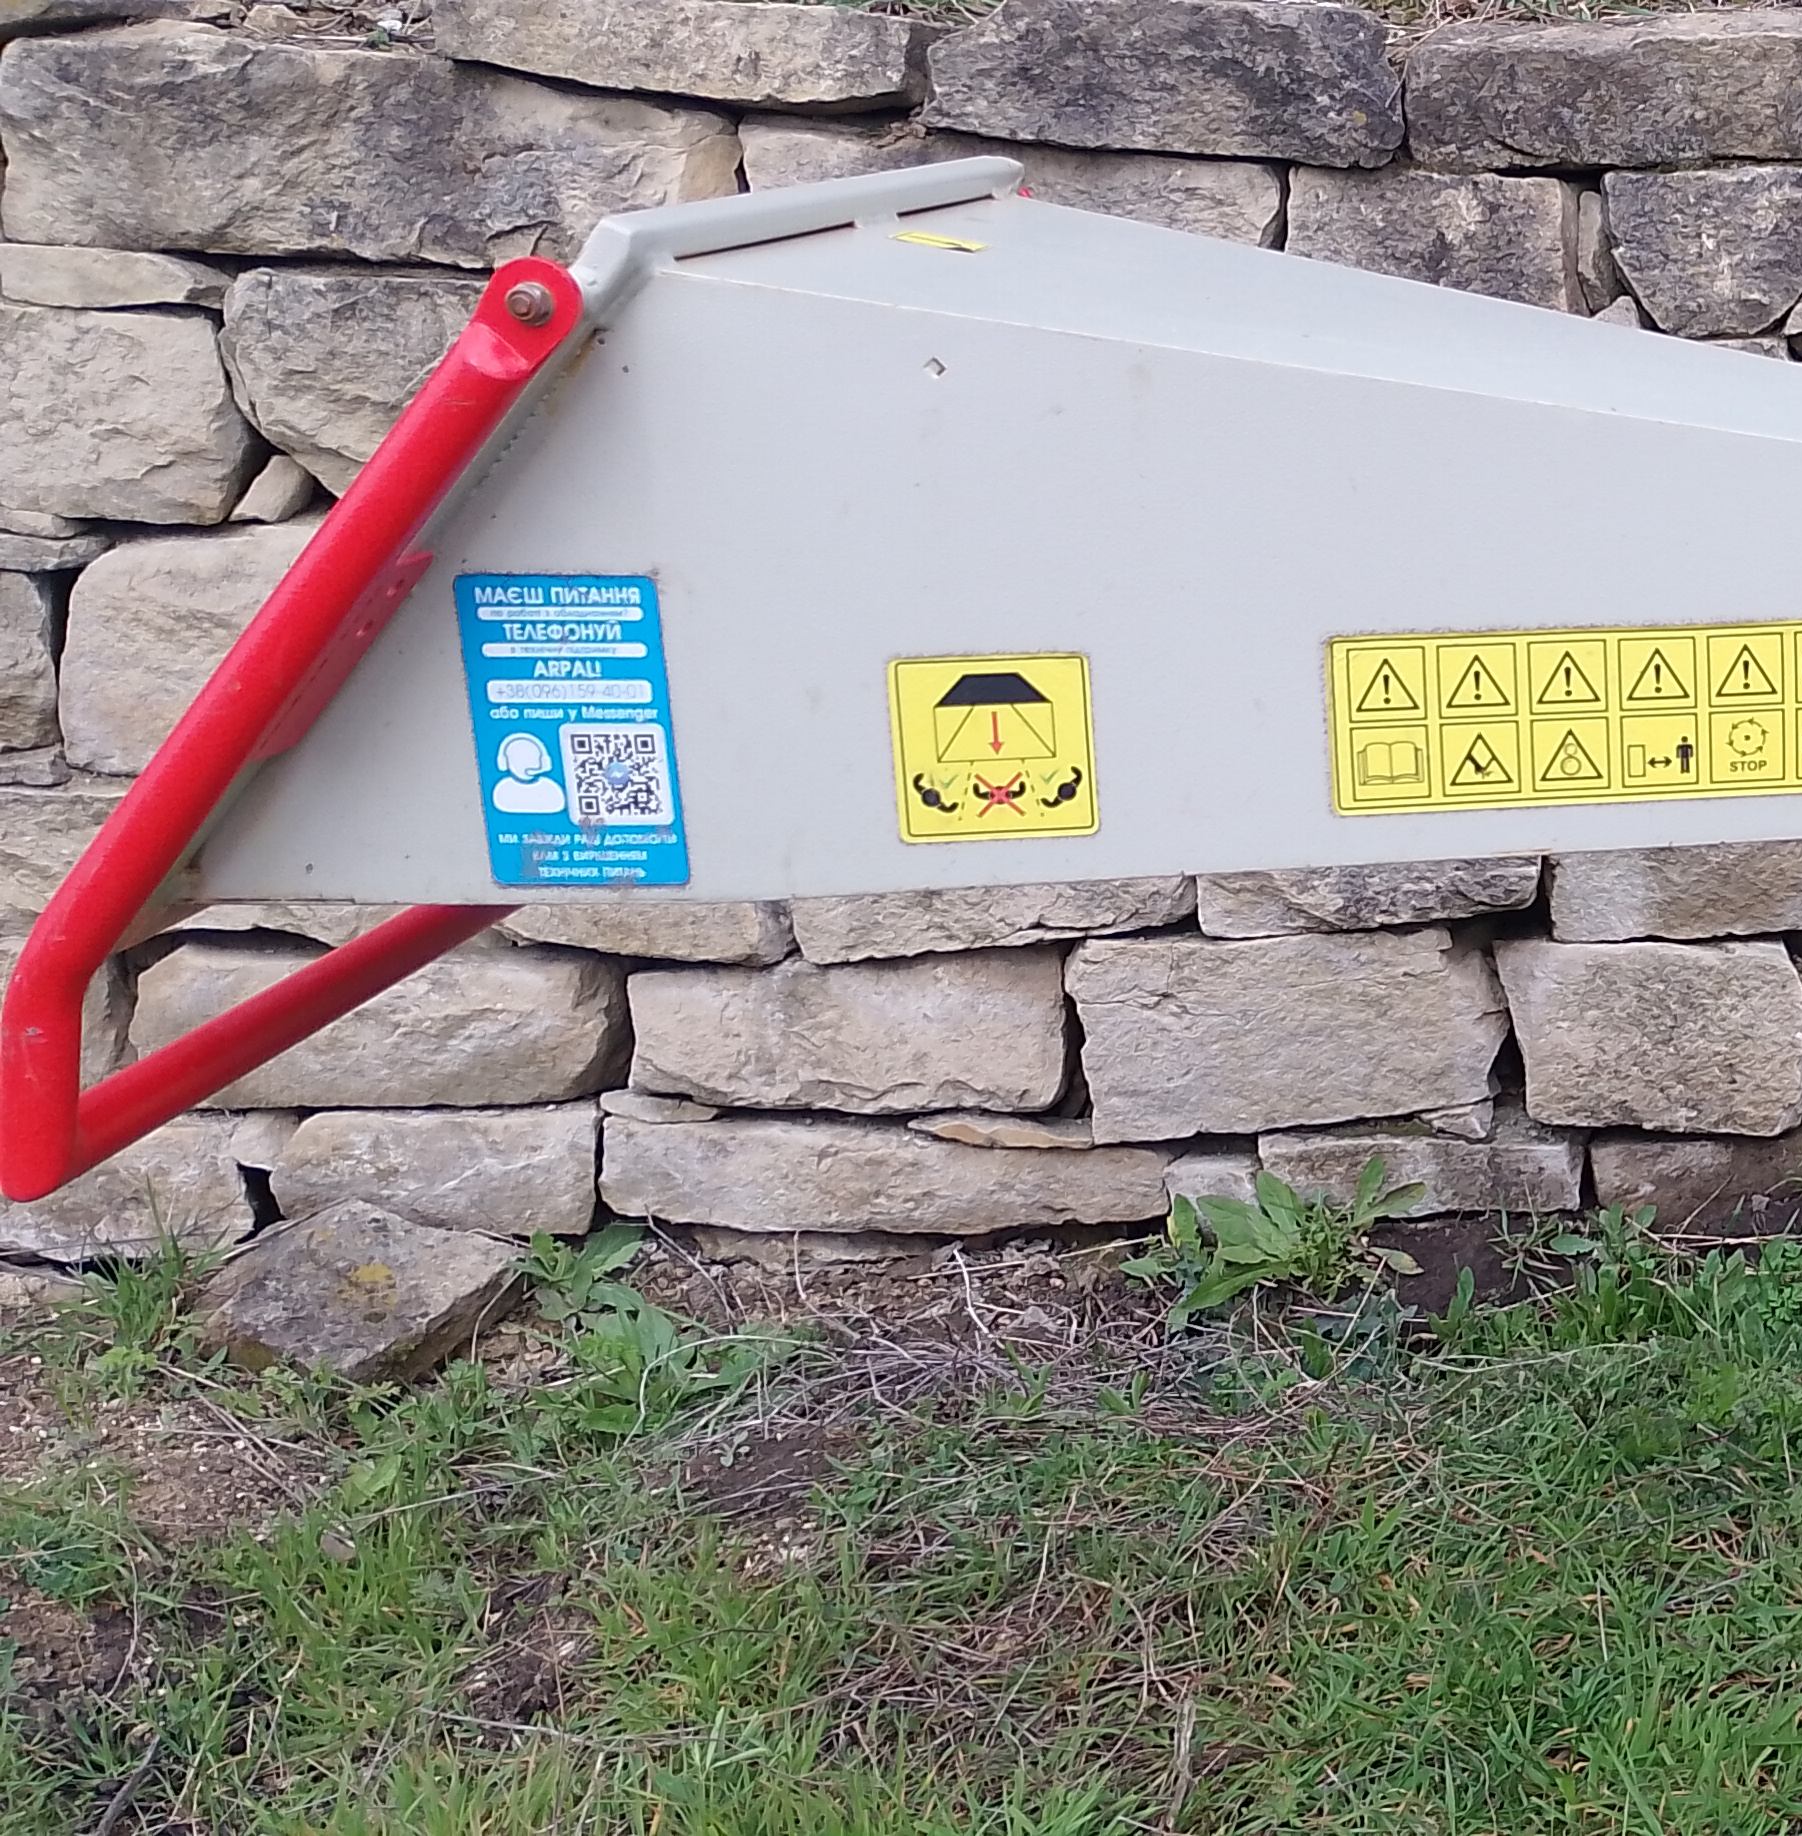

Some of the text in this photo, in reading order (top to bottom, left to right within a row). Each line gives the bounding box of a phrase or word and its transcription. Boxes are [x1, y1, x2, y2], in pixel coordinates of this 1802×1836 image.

[474, 586, 641, 605] МАЄШ ПИТАННЯ
[502, 619, 622, 641] ТЕЛЕФОНУЙ
[533, 660, 603, 678] ARPAL!
[489, 705, 519, 719] або
[523, 707, 565, 719] пиши
[581, 705, 659, 722] Messenger
[1729, 760, 1768, 773] STOP
